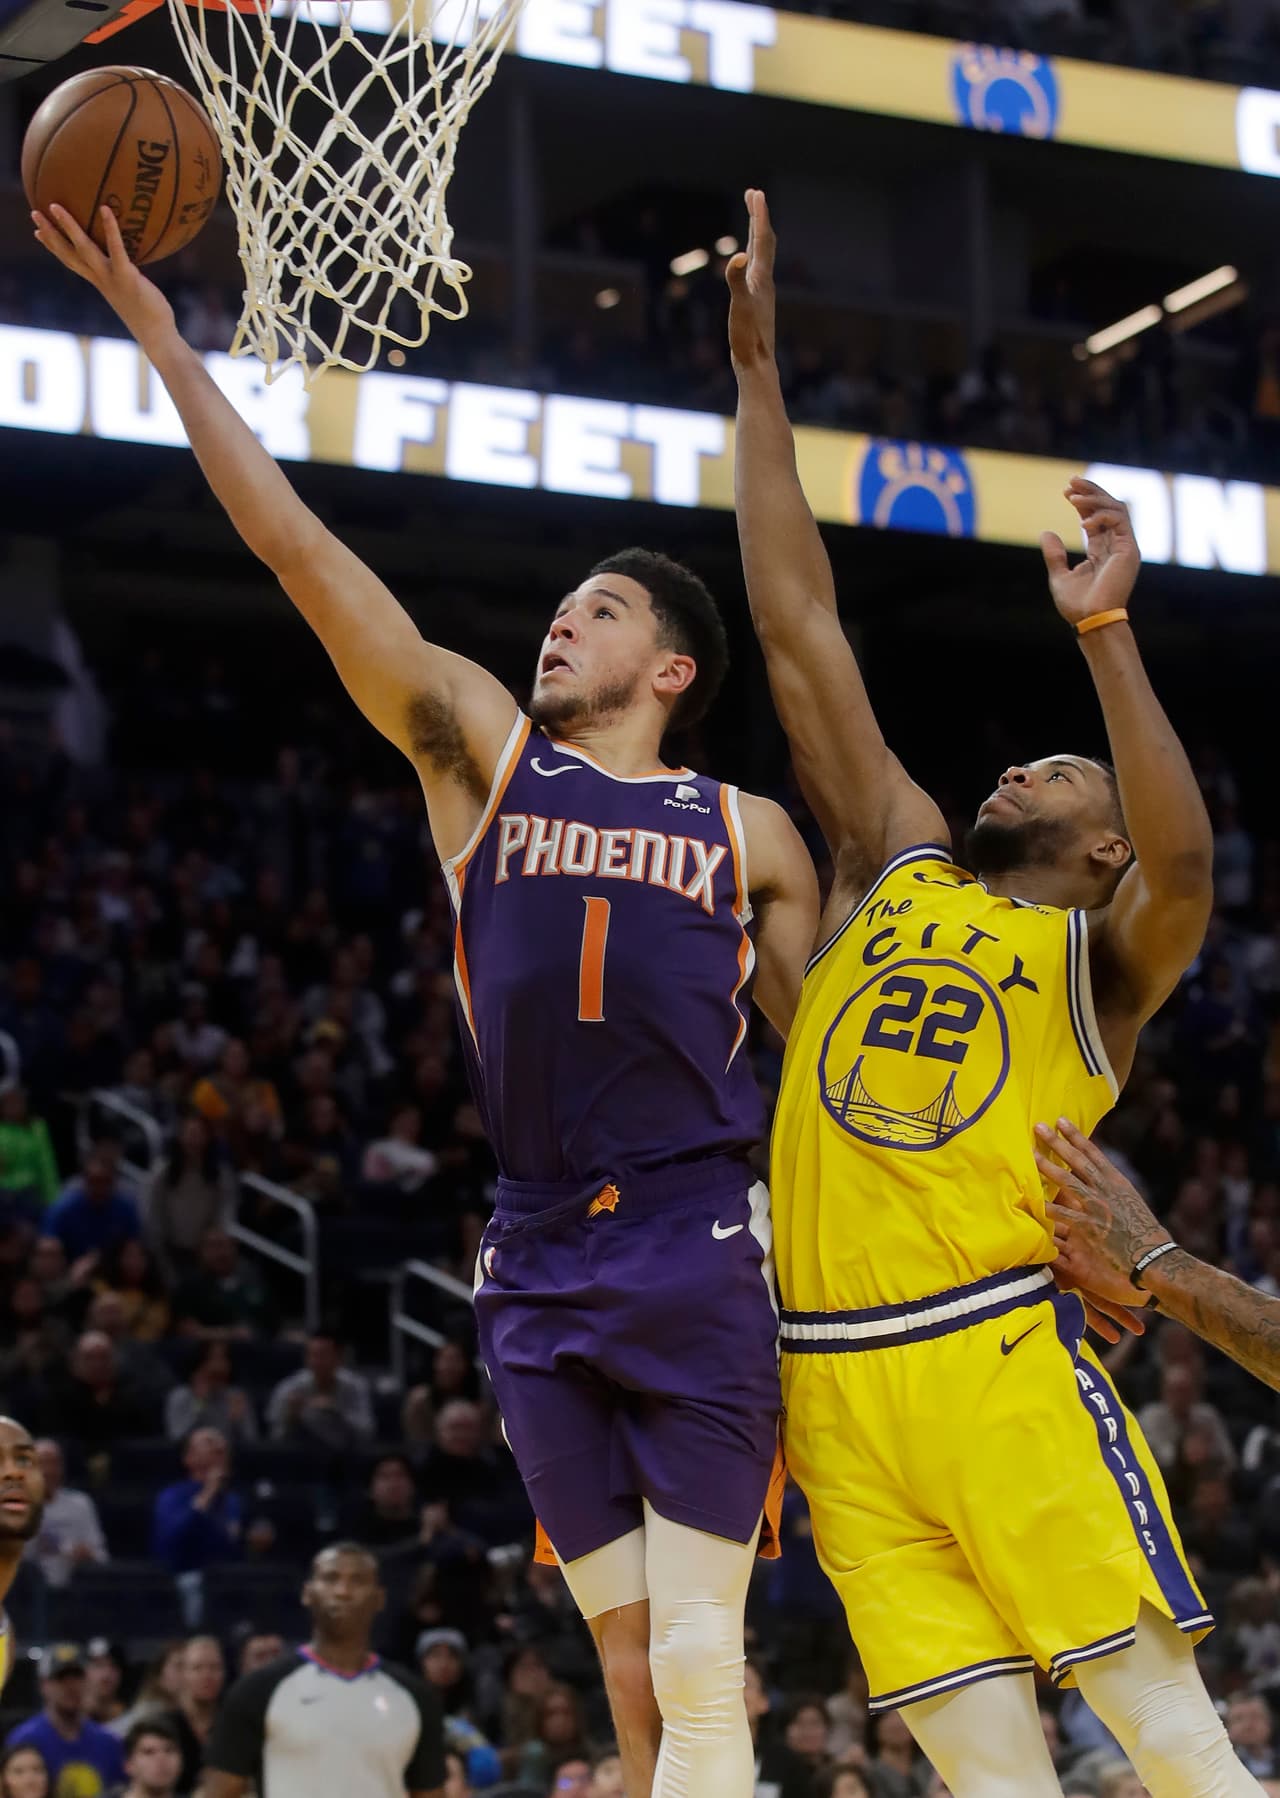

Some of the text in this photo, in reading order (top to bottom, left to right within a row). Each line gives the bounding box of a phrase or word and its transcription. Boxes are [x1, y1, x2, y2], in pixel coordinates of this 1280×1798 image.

[353, 370, 725, 508] FEET
[663, 798, 711, 814] PayPal
[495, 814, 728, 917] PHOENIX
[865, 898, 913, 927] The
[578, 896, 611, 1022] 1
[862, 922, 1040, 995] CITY
[861, 975, 985, 1065] 22
